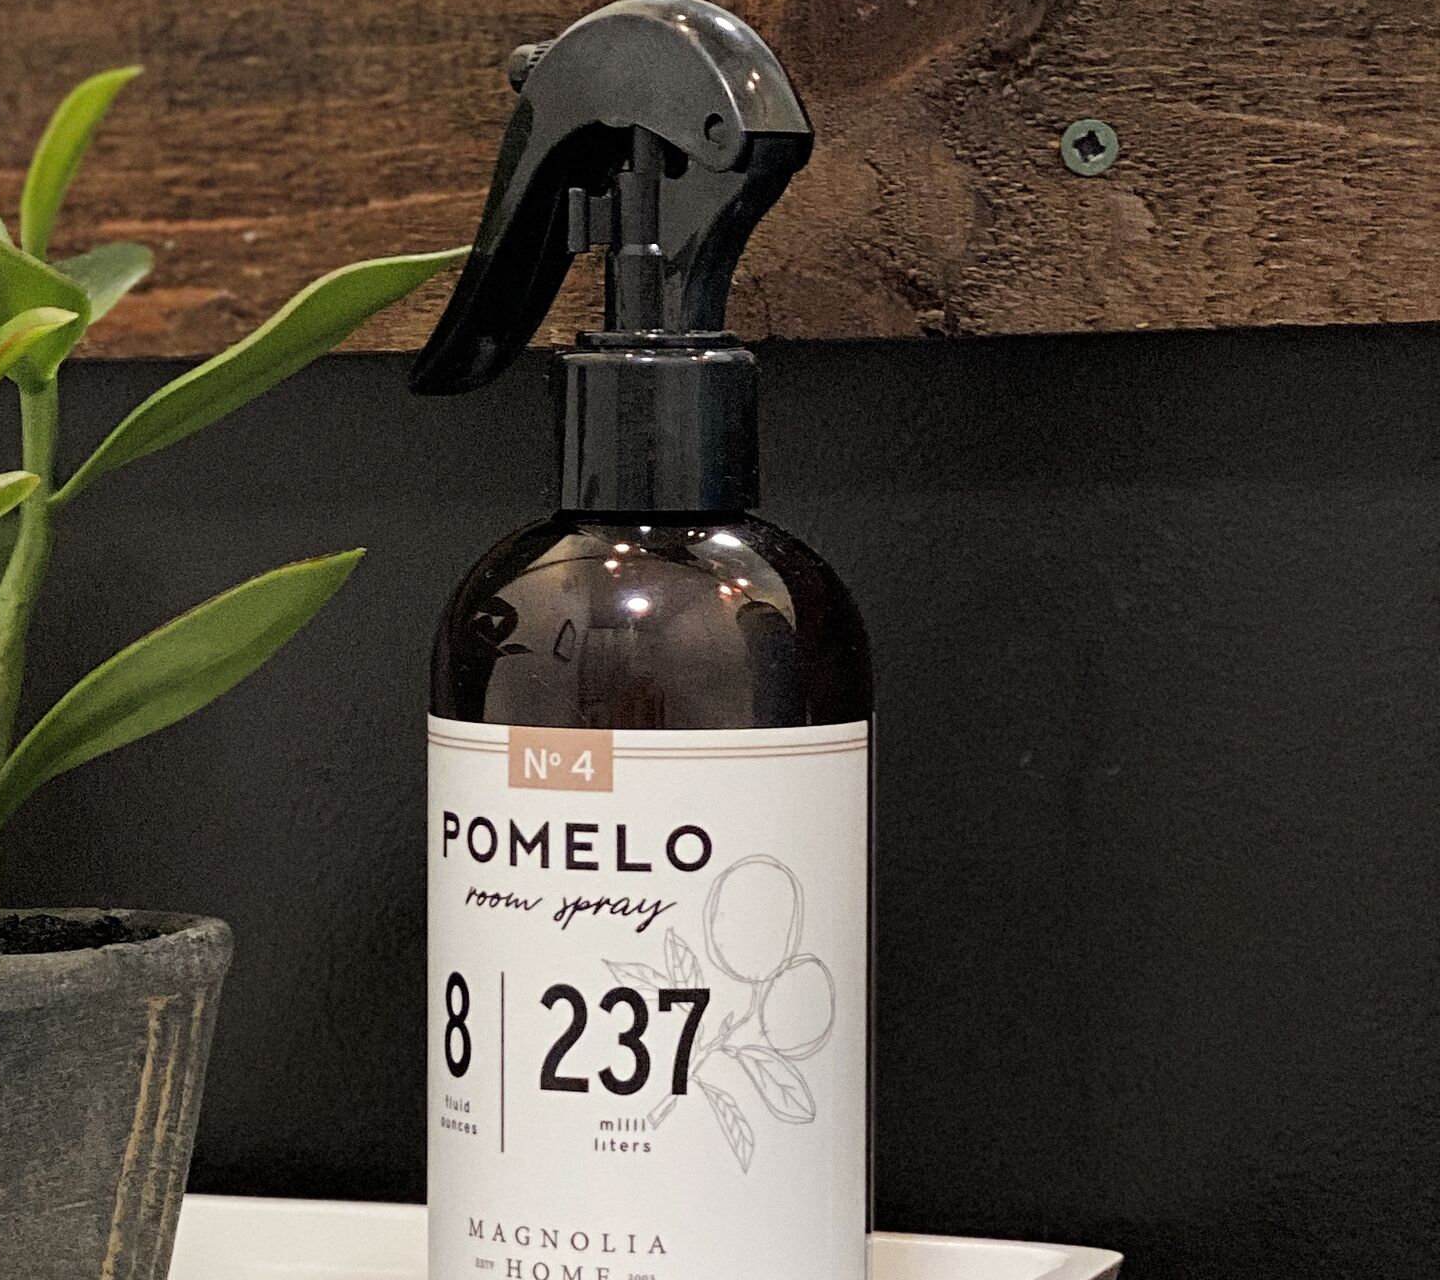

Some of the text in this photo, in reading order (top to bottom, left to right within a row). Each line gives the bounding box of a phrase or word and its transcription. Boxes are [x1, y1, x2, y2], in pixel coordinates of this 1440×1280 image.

[571, 750, 594, 781] 4
[443, 810, 712, 872] POMELO
[465, 885, 678, 933] room spray
[444, 971, 472, 1078] 8
[539, 983, 711, 1096] 237
[445, 1094, 470, 1113] fluid
[440, 1115, 478, 1135] ounces
[594, 1137, 651, 1152] liters
[468, 1217, 667, 1254] MAGNOLIA
